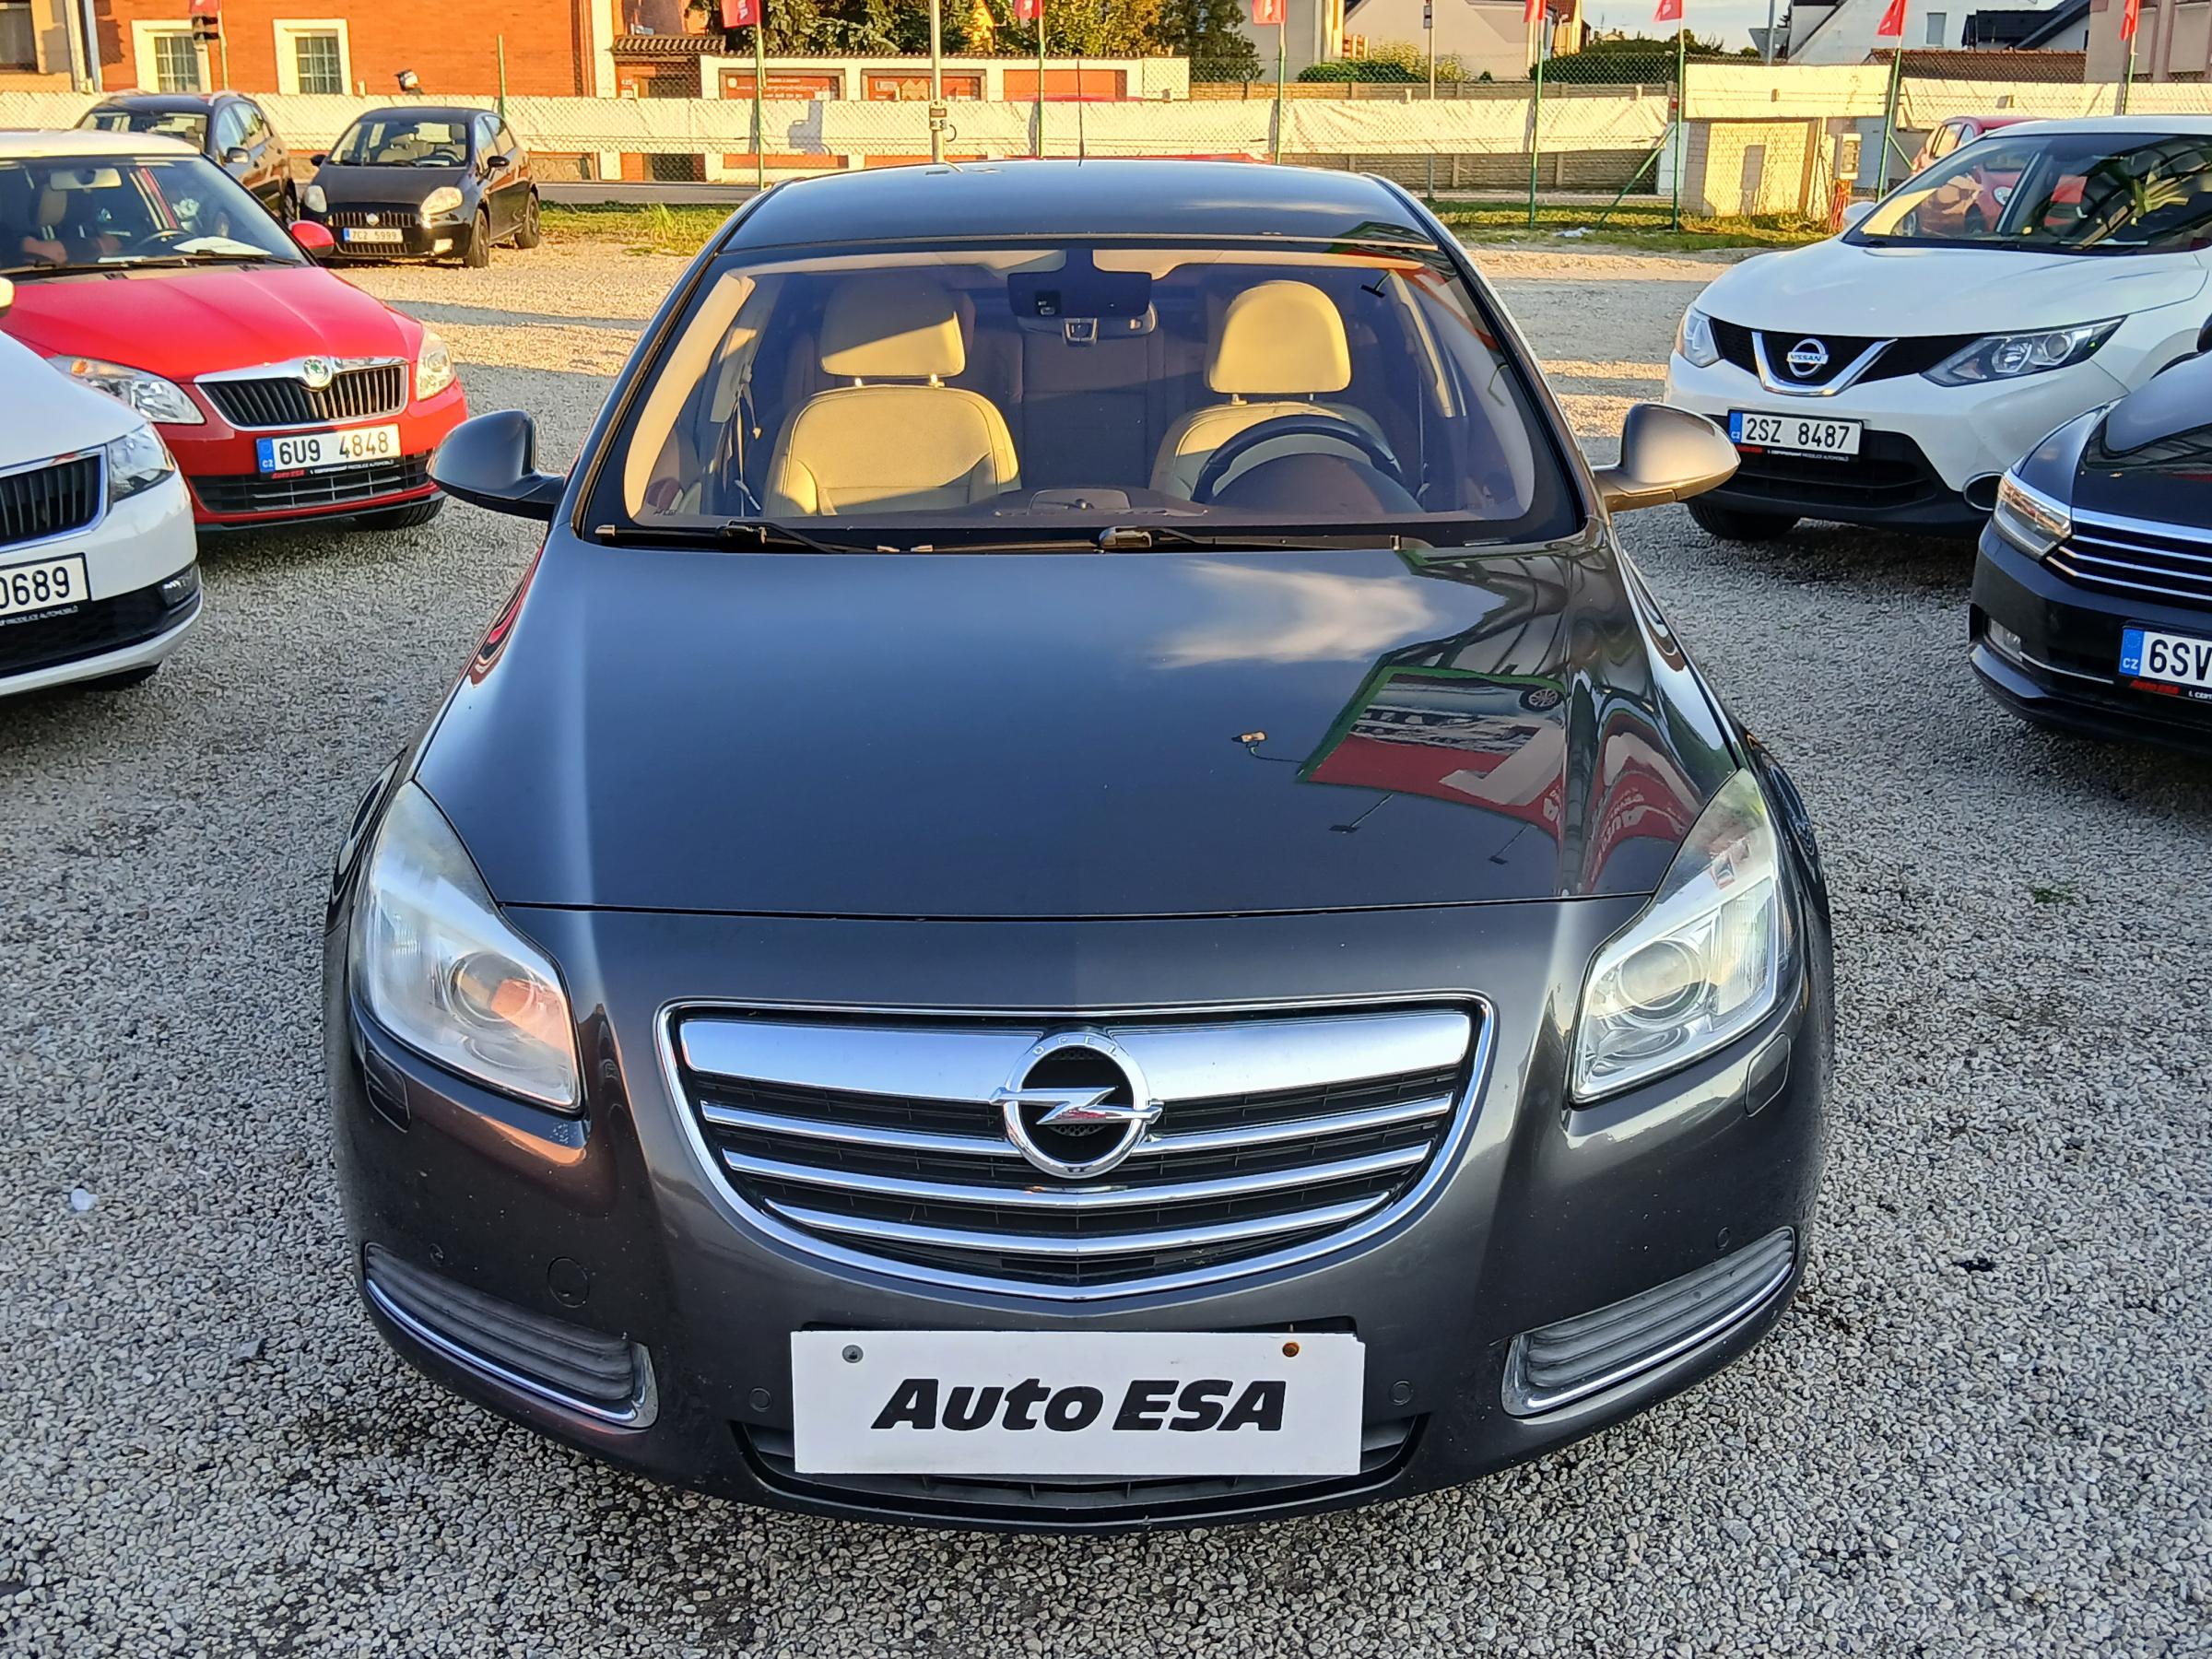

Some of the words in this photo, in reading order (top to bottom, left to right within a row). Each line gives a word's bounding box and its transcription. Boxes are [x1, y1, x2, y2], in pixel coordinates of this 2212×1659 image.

[1791, 354, 1822, 362] NISSAN
[278, 439, 321, 465] 6U9
[339, 431, 389, 458] 4848
[1746, 418, 1783, 443] 2SZ
[1797, 422, 1850, 450] 8487
[2123, 657, 2139, 670] CZ
[2148, 639, 2212, 681] 6SV
[1032, 1035, 1117, 1057] OPEL
[870, 1377, 1104, 1432] Auto
[1112, 1379, 1288, 1432] ESA
